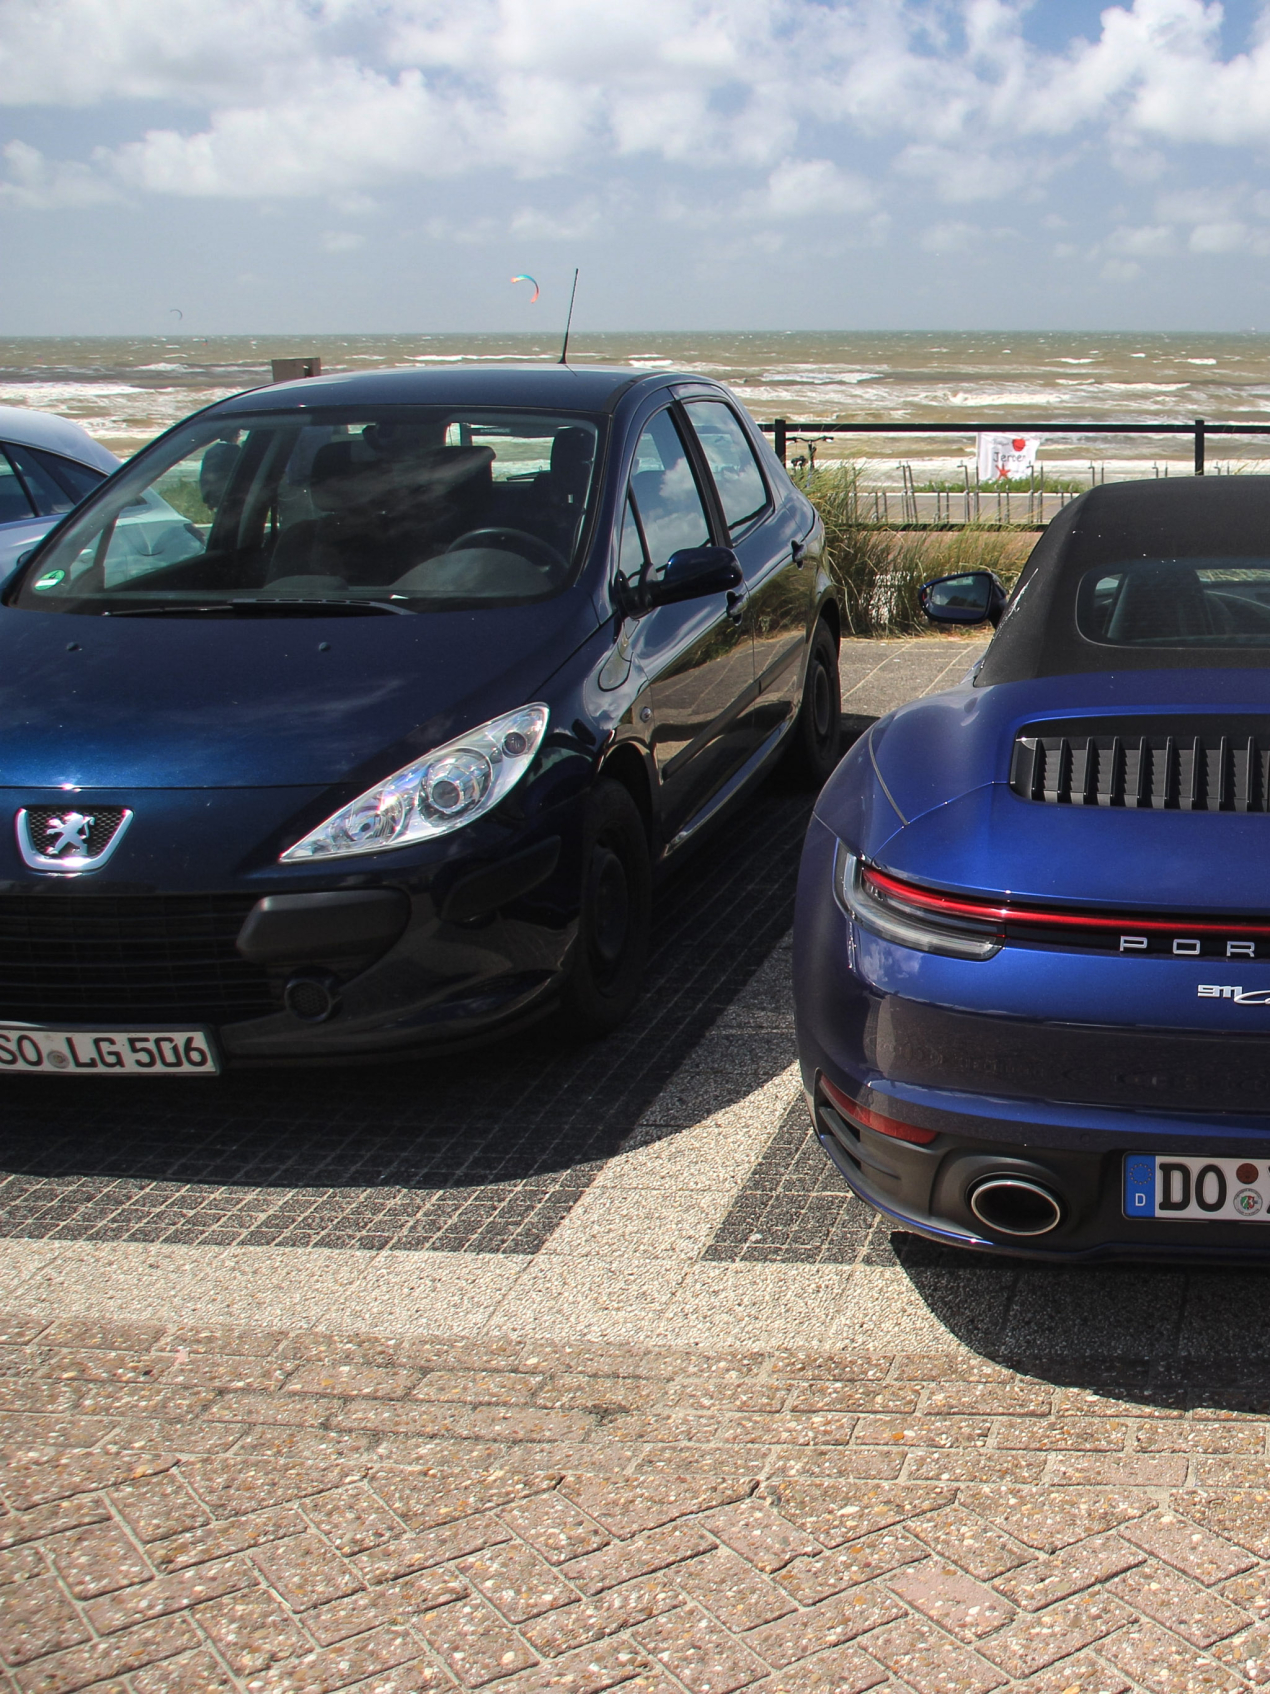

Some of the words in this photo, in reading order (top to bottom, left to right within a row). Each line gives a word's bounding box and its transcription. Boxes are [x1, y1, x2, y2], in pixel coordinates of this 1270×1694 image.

[1198, 984, 1242, 998] 911
[0, 1033, 45, 1067] SO
[65, 1036, 126, 1068] LG
[127, 1036, 209, 1068] 506
[1134, 1192, 1146, 1207] D
[1158, 1162, 1228, 1213] DO
